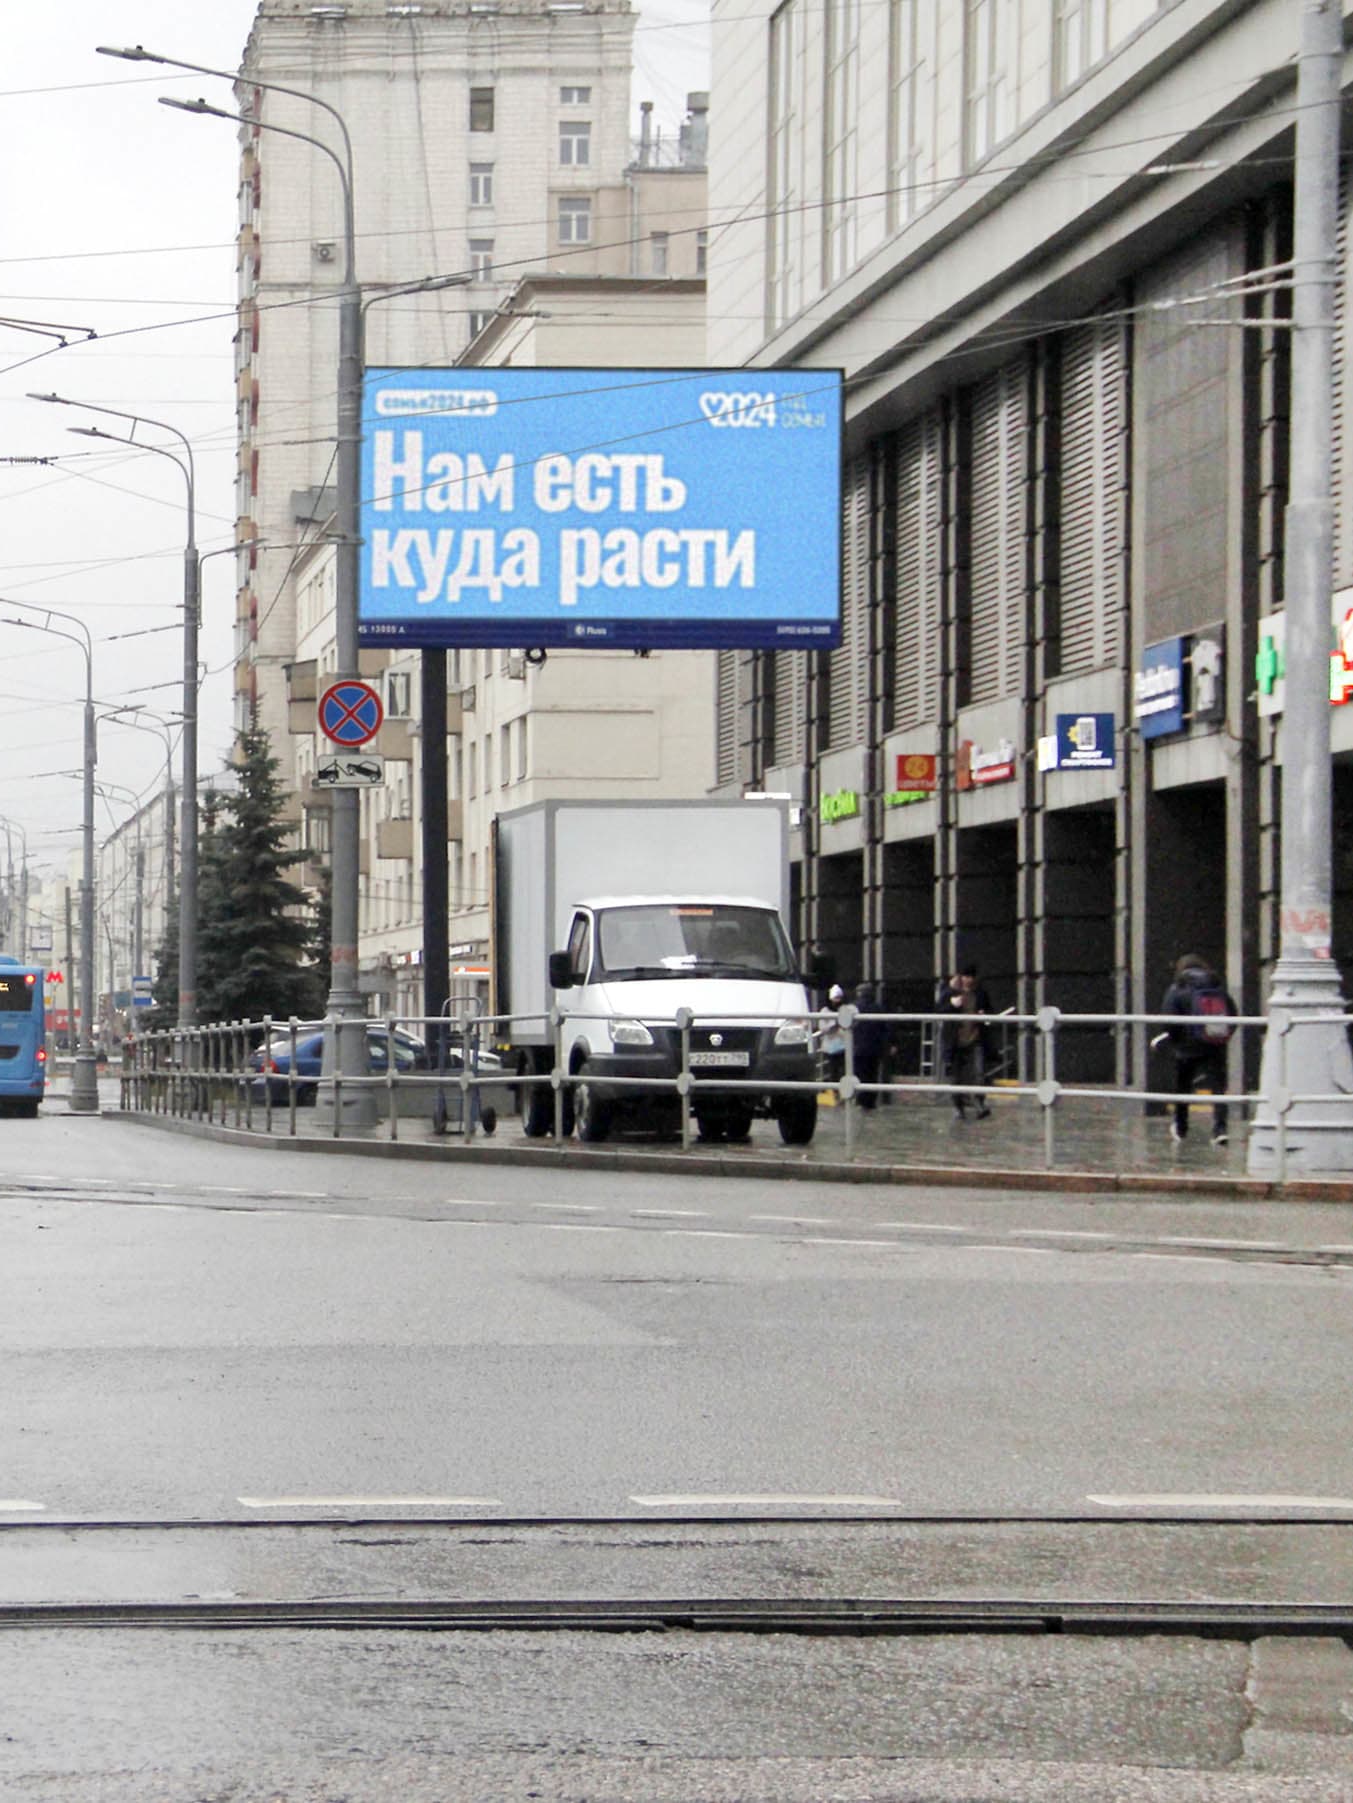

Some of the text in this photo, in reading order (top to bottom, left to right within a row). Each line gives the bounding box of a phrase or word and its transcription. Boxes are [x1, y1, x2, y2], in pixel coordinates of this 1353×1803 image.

[373, 430, 688, 513] Нам есть
[371, 528, 755, 606] куда расти
